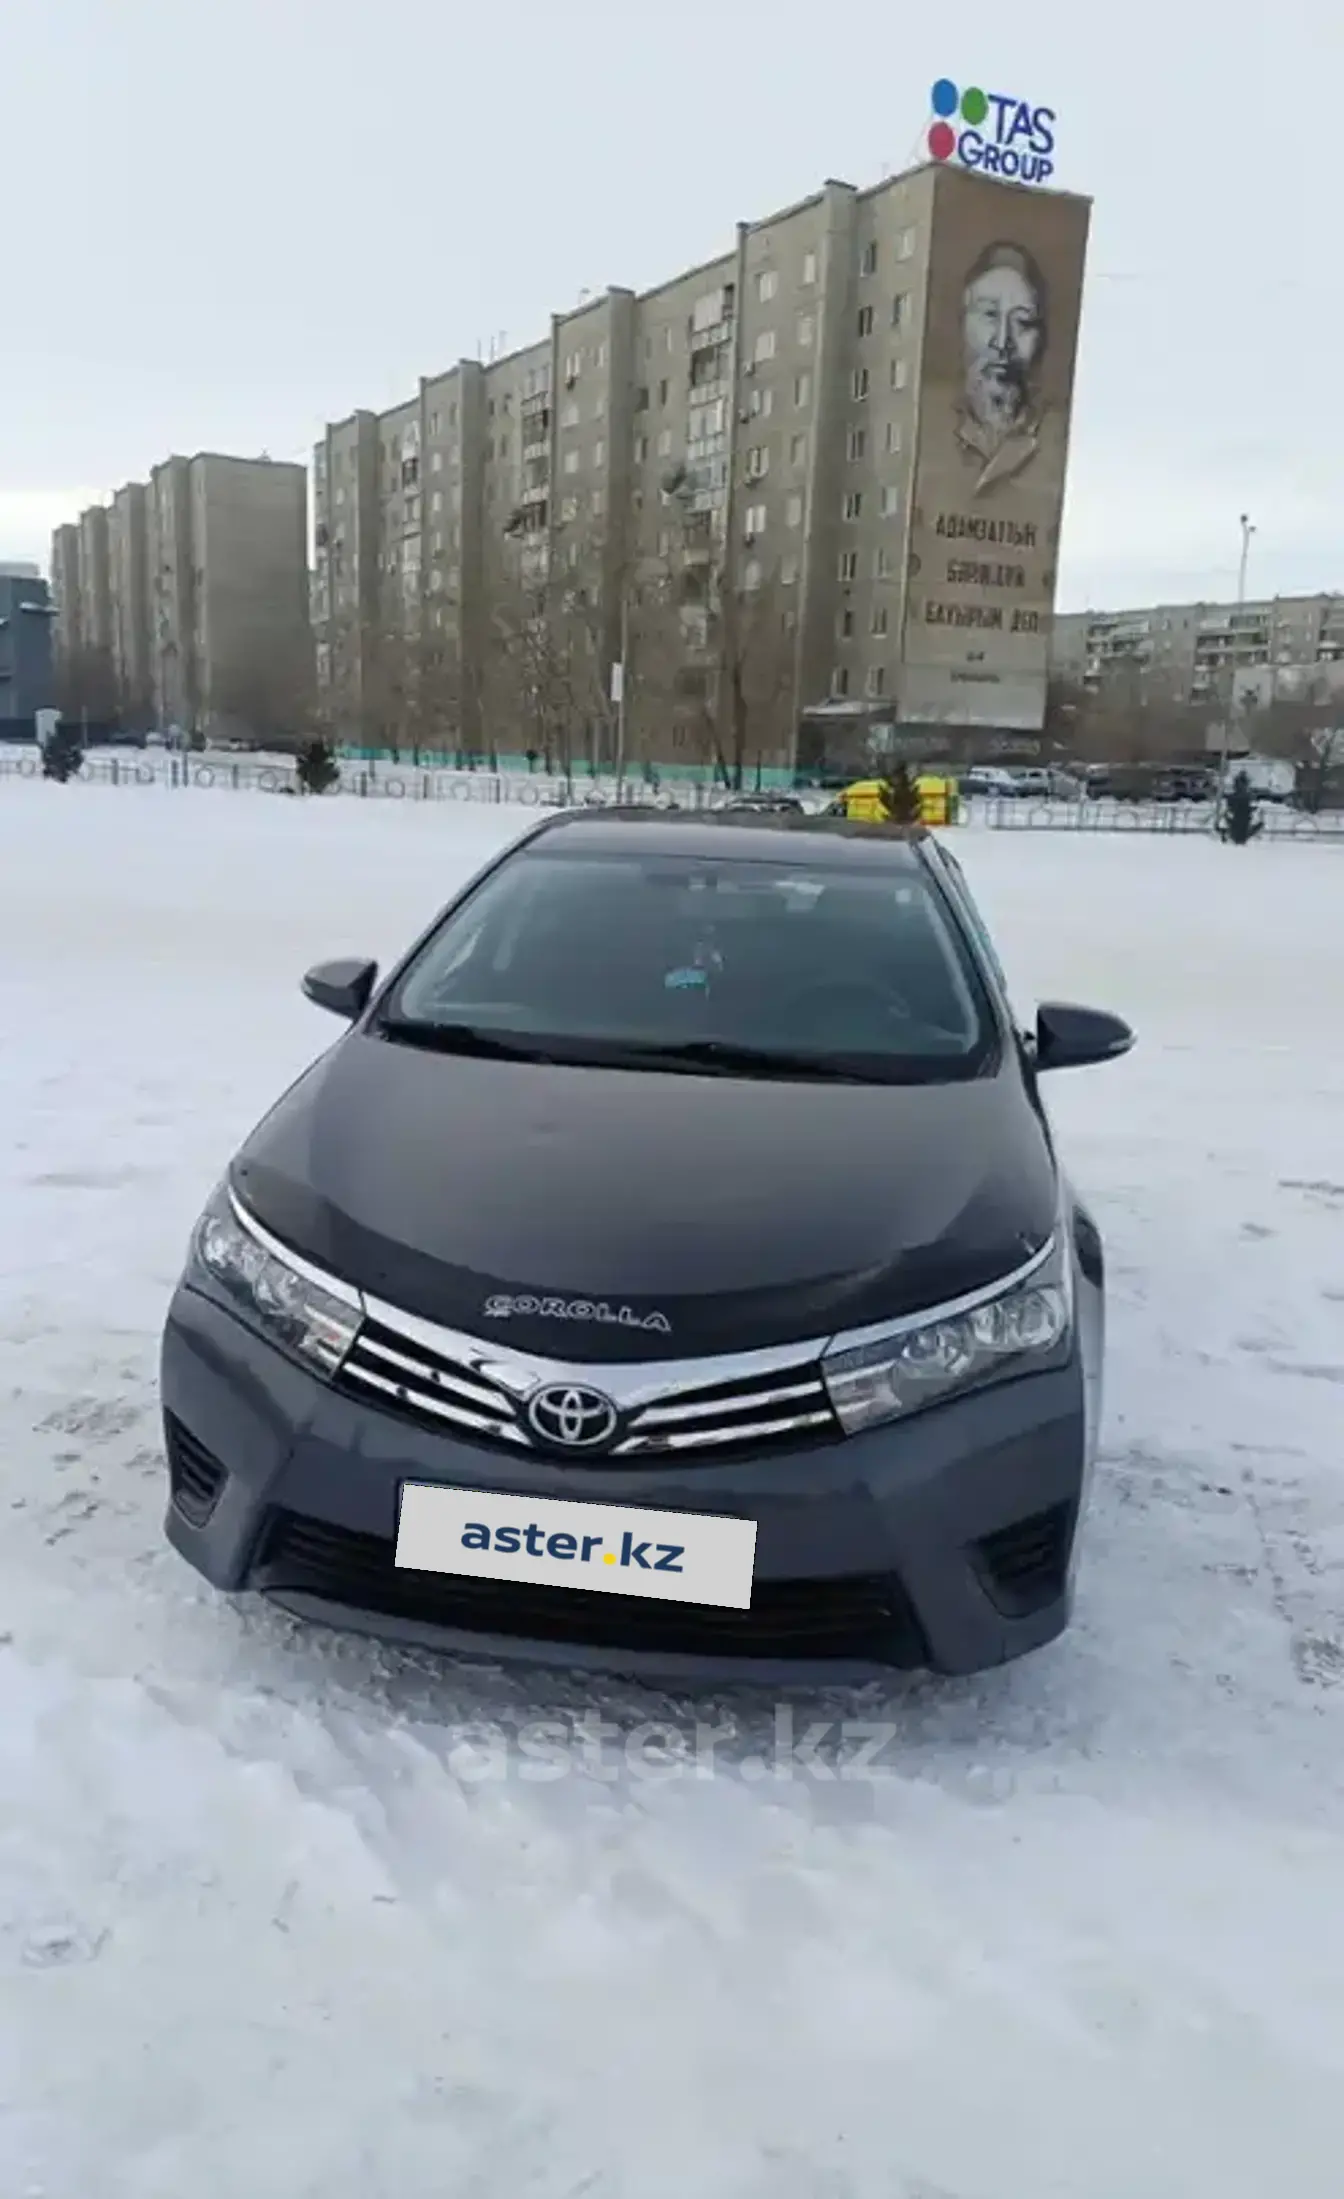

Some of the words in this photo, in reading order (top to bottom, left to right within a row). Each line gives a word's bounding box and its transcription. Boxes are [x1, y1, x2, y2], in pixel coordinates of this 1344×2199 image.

[988, 93, 1056, 154] TAS
[957, 129, 1054, 183] GROUP
[484, 1294, 672, 1332] COROLLA
